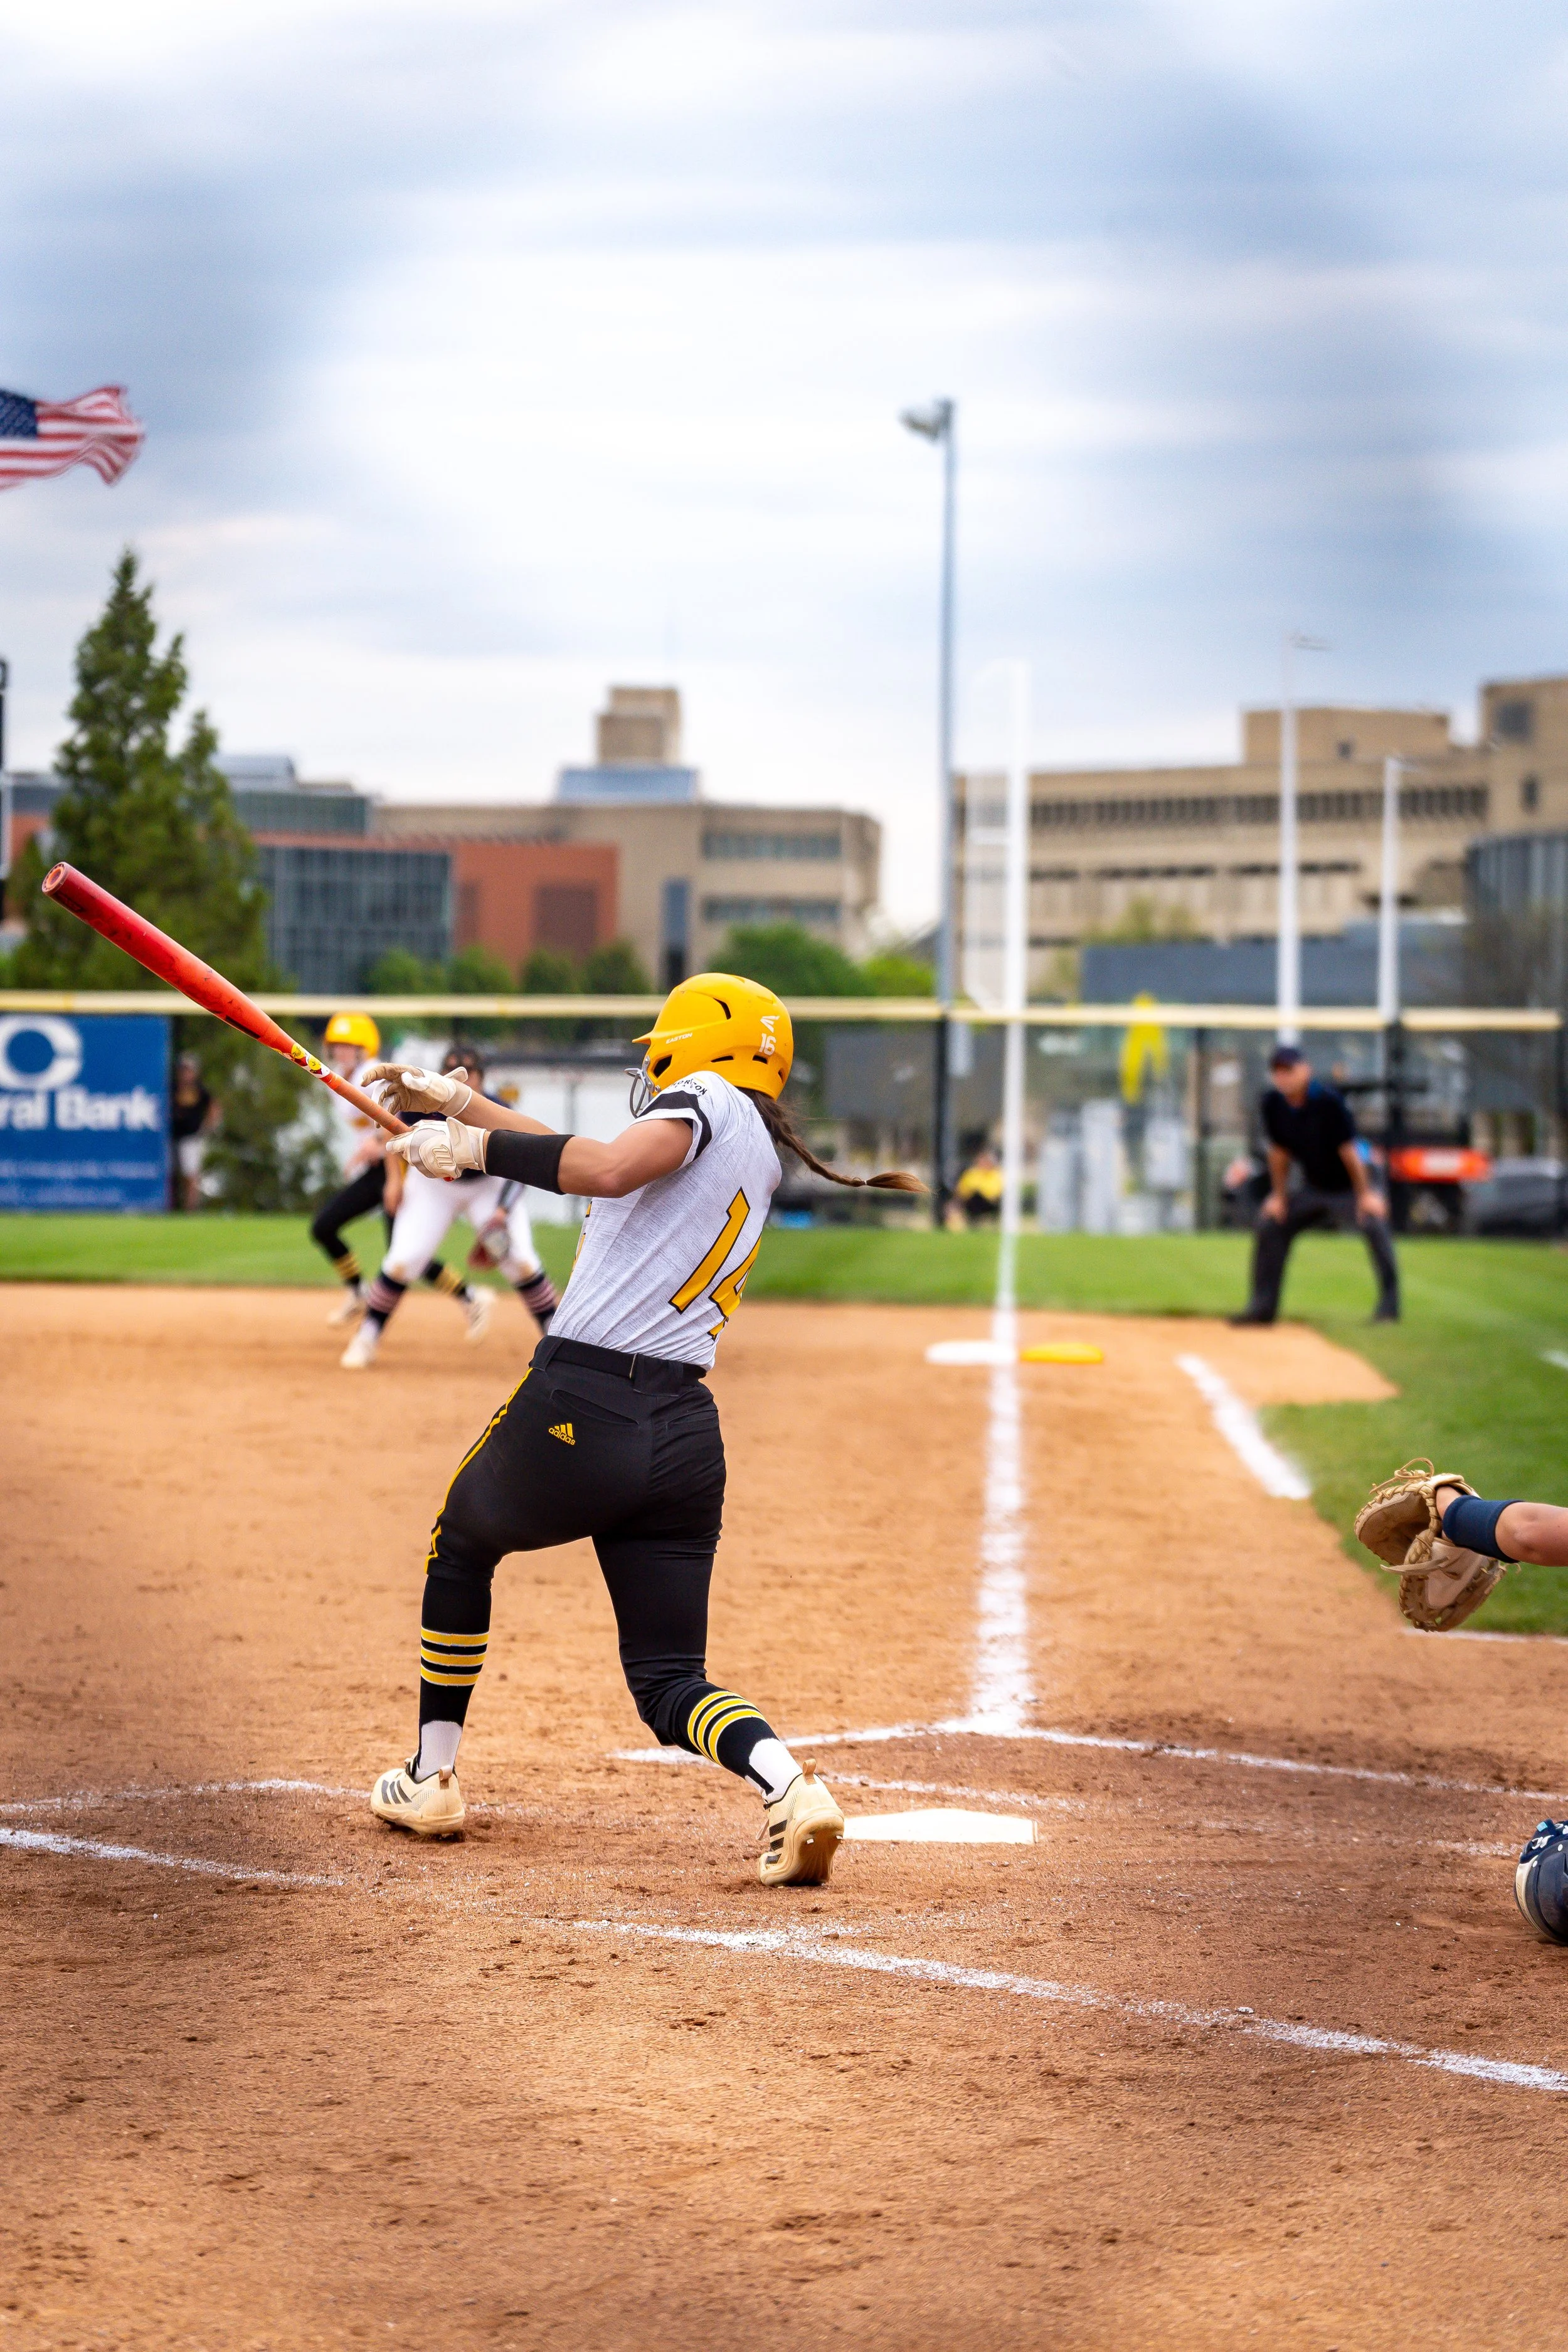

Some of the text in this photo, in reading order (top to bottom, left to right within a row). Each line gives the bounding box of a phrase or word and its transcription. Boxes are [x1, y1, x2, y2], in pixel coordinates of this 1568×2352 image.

[665, 1032, 692, 1044] EASTON
[758, 1033, 776, 1056] 16
[668, 1186, 762, 1342] 14
[548, 1428, 576, 1445] adidas
